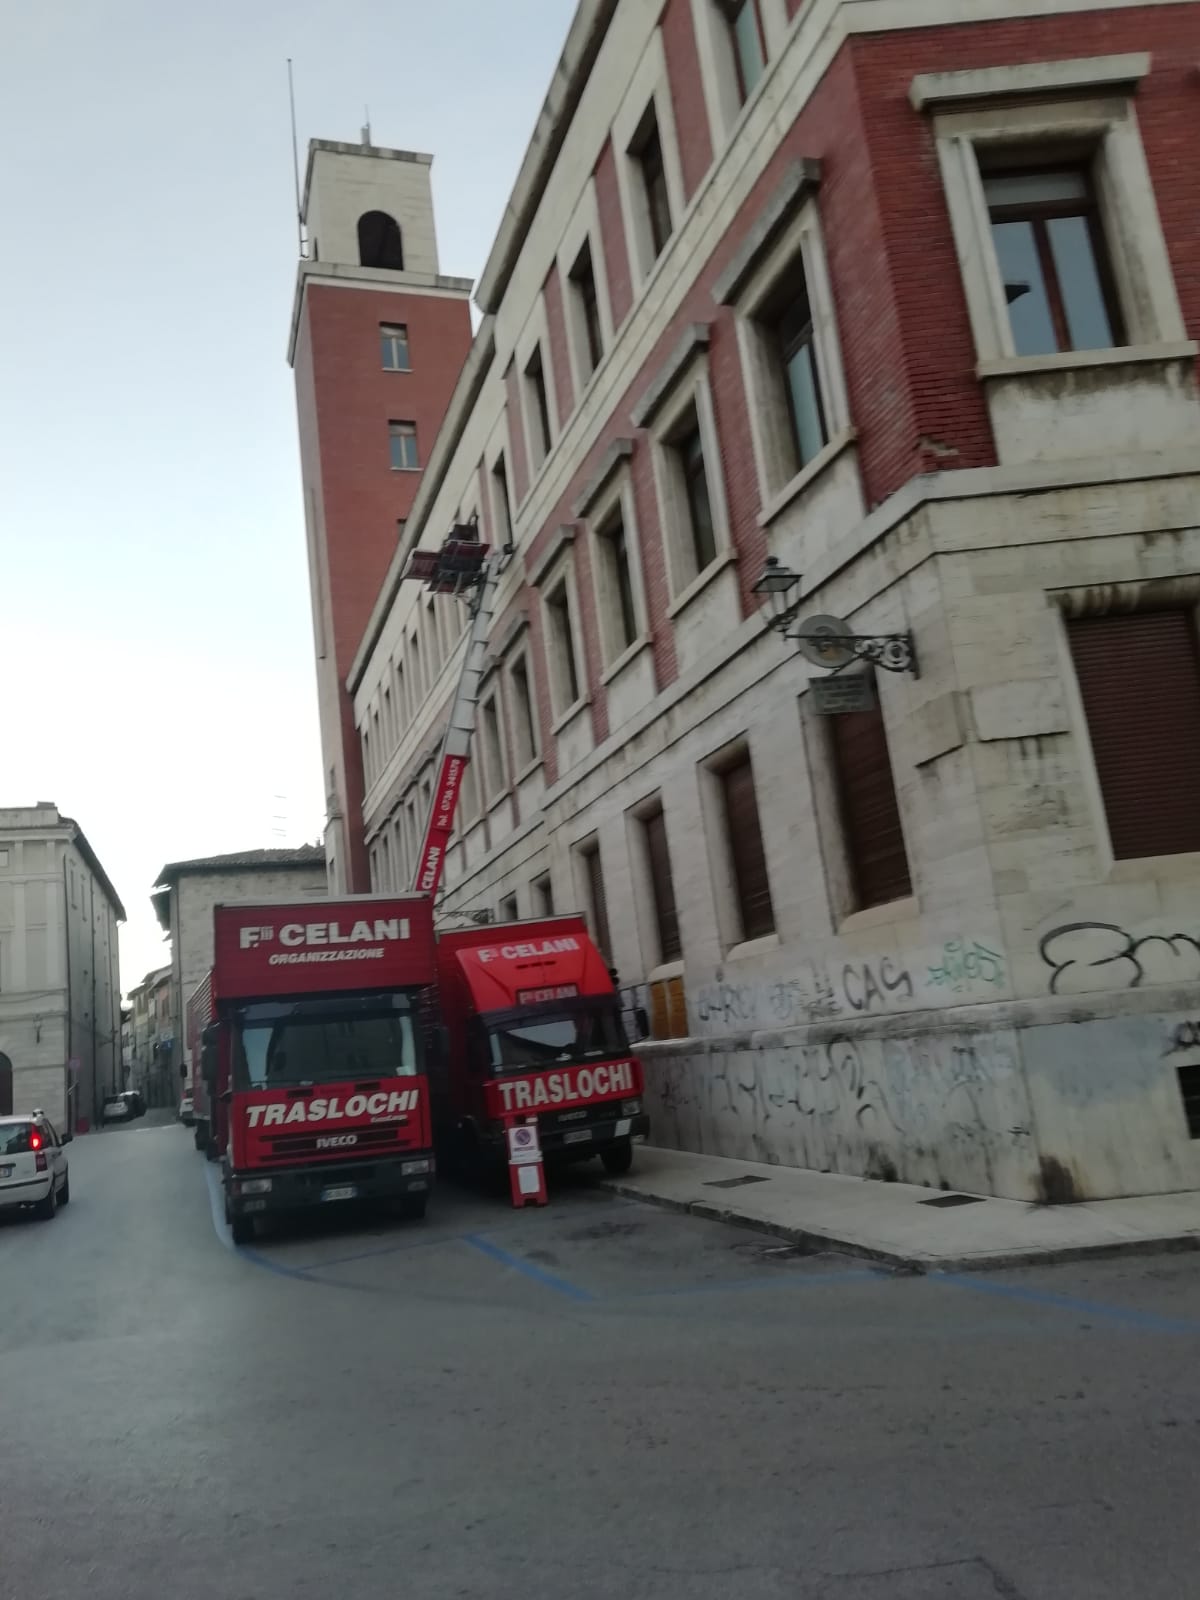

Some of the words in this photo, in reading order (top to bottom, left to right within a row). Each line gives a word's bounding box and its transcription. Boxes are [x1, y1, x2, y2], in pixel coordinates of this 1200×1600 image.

[421, 846, 442, 890] CELANI
[278, 918, 411, 947] CELANI
[268, 947, 385, 965] ORGANIZZAZIONE
[500, 937, 581, 960] CELANI
[498, 1062, 634, 1111] TRASLOCHI
[245, 1088, 420, 1129] TRASLOCHI
[315, 1133, 359, 1150] IVECO
